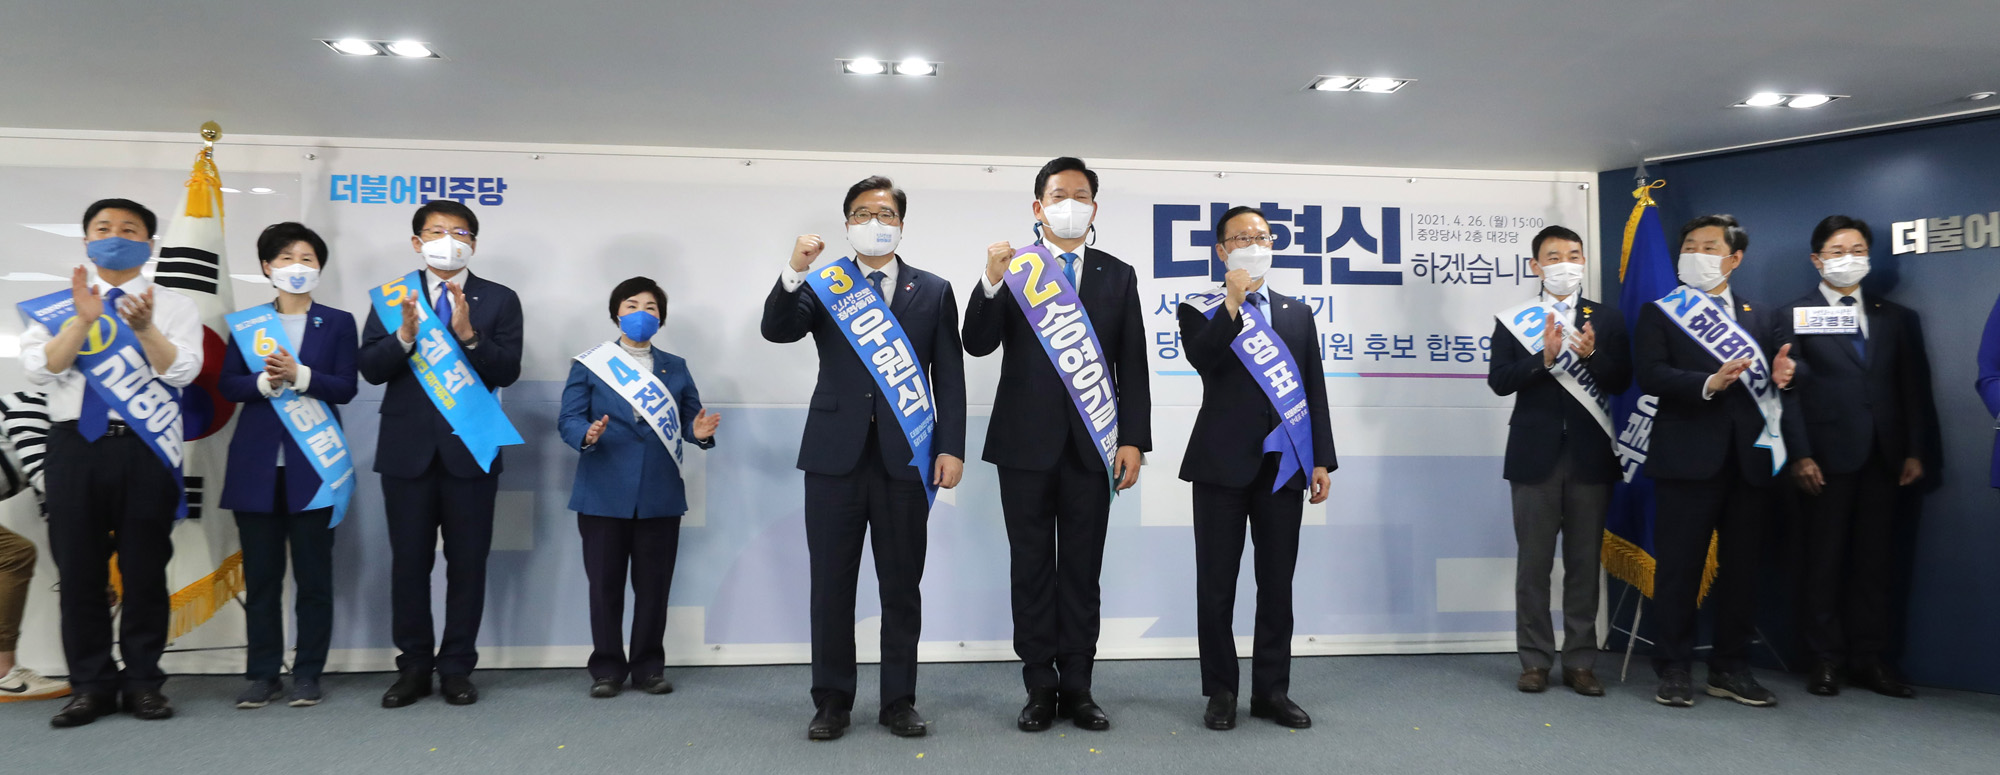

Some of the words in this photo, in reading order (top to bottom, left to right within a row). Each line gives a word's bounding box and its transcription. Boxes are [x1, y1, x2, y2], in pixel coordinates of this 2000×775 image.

[330, 174, 508, 207] 더불어민주당
[1416, 228, 1461, 242] 중앙당사
[1465, 230, 1483, 243] 2층
[1487, 230, 1519, 243] 대강당
[1417, 214, 1450, 226] 2021.
[1453, 215, 1464, 227] 4.
[1468, 216, 1486, 228] 26.
[1489, 215, 1508, 229] (월)
[1512, 217, 1544, 229] 15:00
[820, 265, 854, 295] 3
[1008, 252, 1062, 309] 2
[1513, 306, 1550, 338] 3
[1809, 315, 1855, 327] 강병원
[253, 327, 278, 357] 6
[1364, 333, 1417, 361] 후보
[607, 356, 641, 387] 4
[850, 308, 931, 418] 우원식
[1037, 301, 1117, 433] 송영길
[283, 396, 347, 468] 혜련
